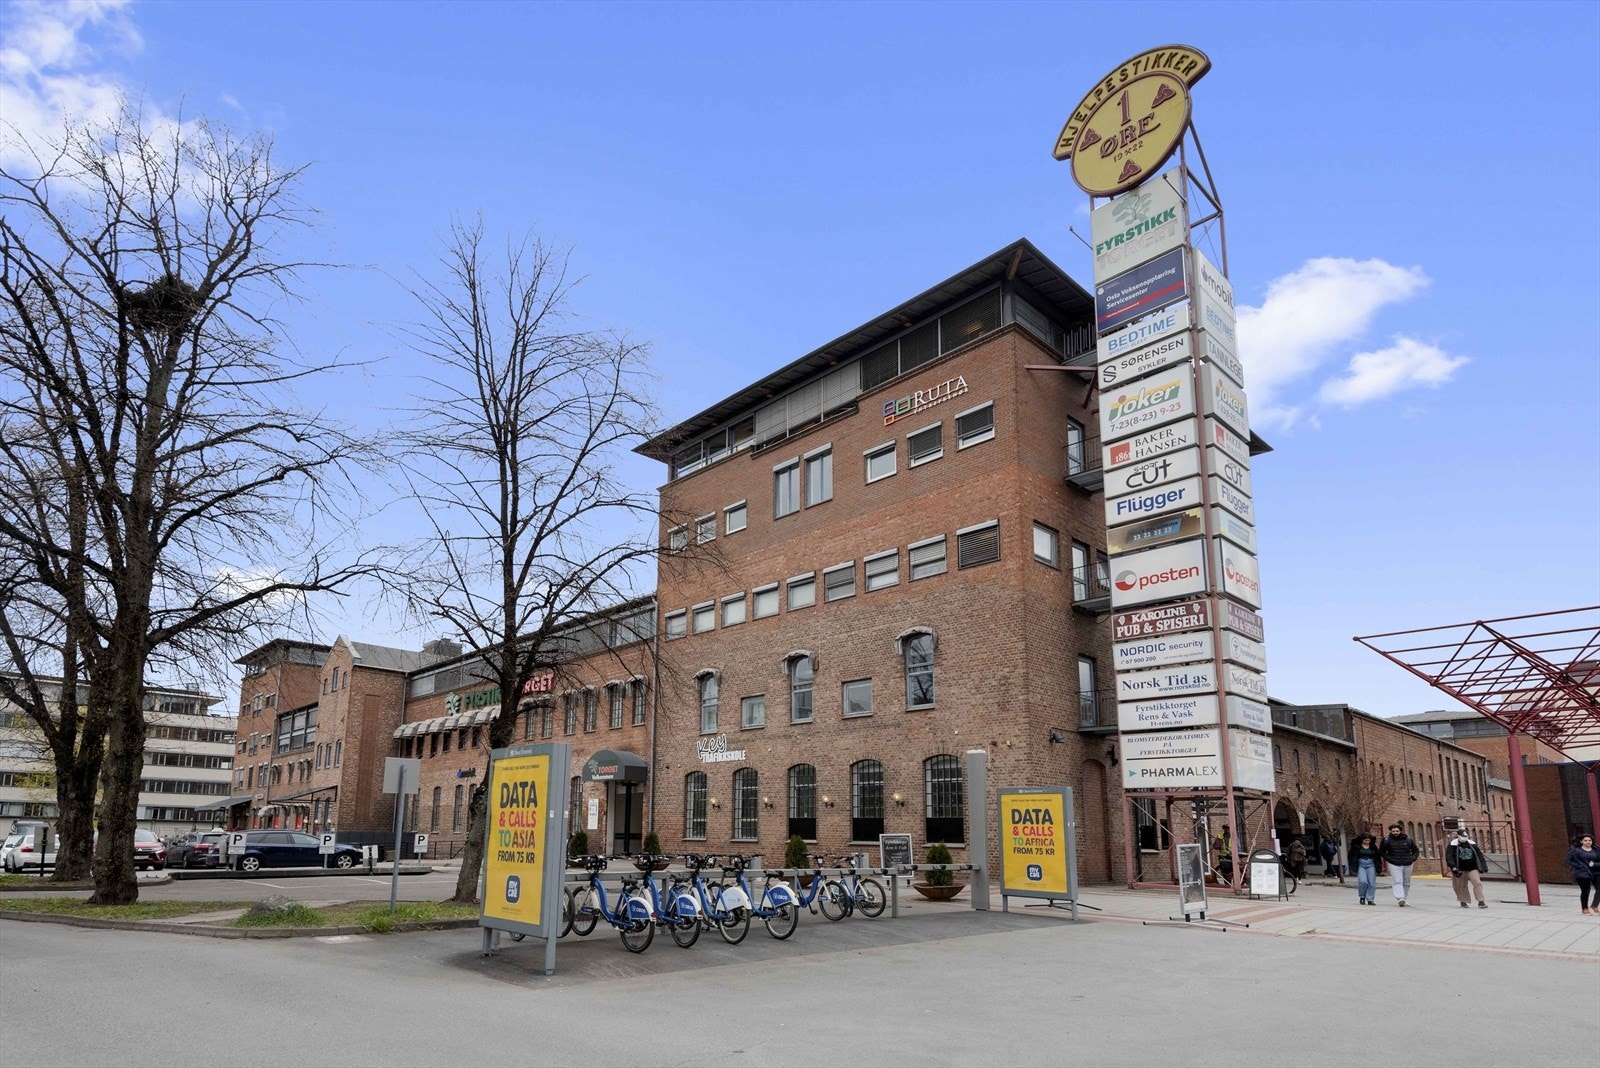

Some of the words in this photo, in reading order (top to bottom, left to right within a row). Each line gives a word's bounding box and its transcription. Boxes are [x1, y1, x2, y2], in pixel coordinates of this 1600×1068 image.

[1060, 52, 1198, 147] HJELPESTIKKER
[1117, 90, 1131, 126] 1
[1100, 112, 1161, 159] ØRE
[1096, 207, 1177, 256] FYRSTIKK
[1106, 293, 1120, 302] Oslo
[1121, 267, 1176, 295] Voksenopplæring
[1208, 277, 1234, 310] mobit
[1106, 287, 1149, 309] Servicesenter
[1206, 305, 1234, 340] BEDTIME
[1108, 315, 1176, 351] BEDTIME
[1121, 338, 1184, 369] SØRENSEN
[1137, 357, 1167, 373] SYKLER
[914, 375, 968, 408] RUTA
[1217, 380, 1244, 415] joker
[1111, 383, 1177, 423] joker
[1160, 402, 1182, 415] 9-23
[1135, 429, 1173, 447] BAKER
[1135, 435, 1187, 458] HANSEN
[1117, 488, 1186, 515] Flügger
[1222, 485, 1249, 515] Flügger
[1139, 566, 1199, 589] posten
[1235, 572, 1259, 592] posten
[1131, 606, 1187, 623] KAROLINE
[1116, 624, 1140, 637] PUB
[1143, 623, 1154, 634] &
[1156, 614, 1205, 631] SPISERI
[1120, 643, 1166, 657] NORDIC
[1169, 640, 1204, 650] security
[1122, 677, 1160, 691] Norsk
[1165, 674, 1188, 686] Tid
[1193, 674, 1208, 684] as
[1158, 682, 1211, 692] www.norsktid.no
[1136, 700, 1197, 712] Fyrstikktorget
[1138, 712, 1159, 721] Rens
[1172, 710, 1194, 718] Vask
[1127, 733, 1211, 743] BLOMSTERDEKORATØREN
[1140, 748, 1198, 756] FYRSTIKKTORGET
[598, 765, 619, 774] TORGET
[1141, 766, 1218, 778] PHARMALEX
[500, 781, 538, 809] DATA
[499, 811, 506, 828] &
[508, 810, 537, 828] CALLS
[1011, 809, 1053, 825] DATA
[233, 834, 243, 845] P
[323, 835, 332, 845] P
[418, 835, 425, 845] P
[499, 830, 511, 848] TO
[512, 830, 535, 849] ASIA
[1012, 826, 1019, 836] &
[1022, 826, 1053, 837] CALLS
[1013, 838, 1024, 846] TO
[1025, 838, 1055, 846] AFRICA
[1013, 847, 1033, 855] FROM
[497, 850, 515, 863] FROM
[517, 851, 524, 863] 75
[526, 852, 535, 864] KR
